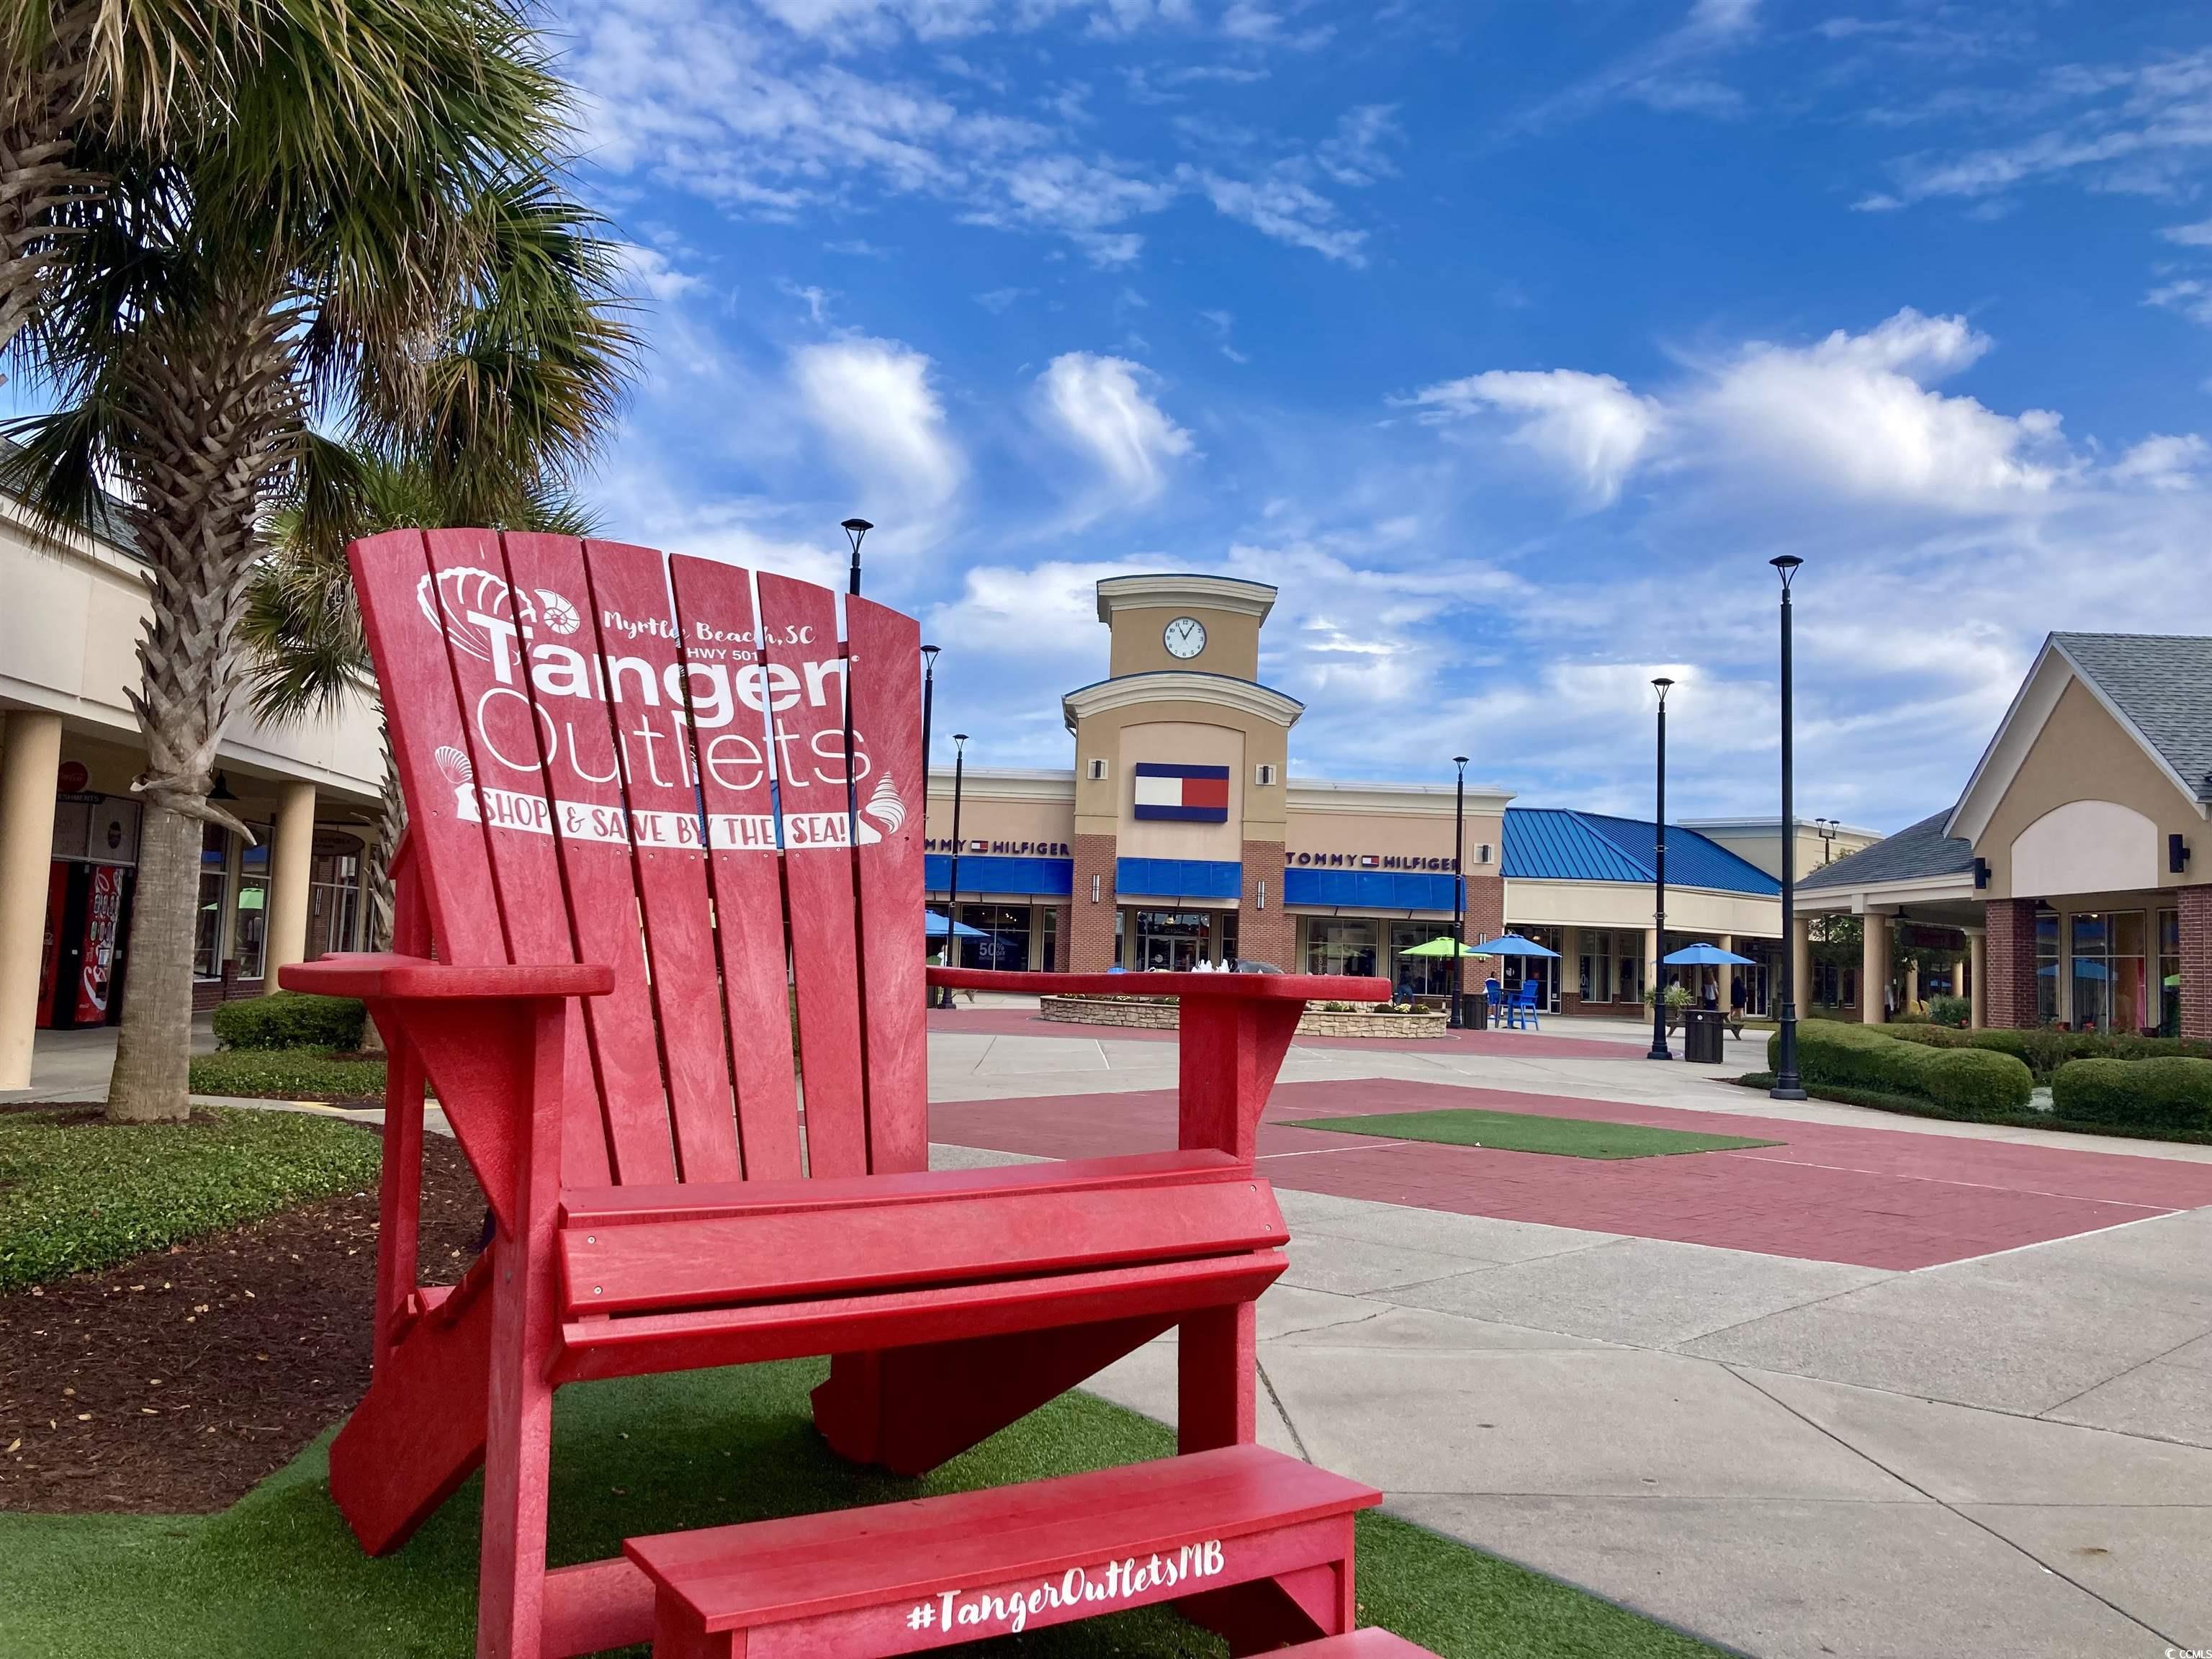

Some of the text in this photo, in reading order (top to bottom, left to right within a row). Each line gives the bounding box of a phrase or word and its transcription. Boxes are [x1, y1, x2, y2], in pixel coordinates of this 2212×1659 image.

[603, 611, 816, 646] Myrtle Beach, SC
[466, 609, 851, 729] Tanger
[686, 647, 758, 661] HWY 501
[477, 687, 871, 791] Outlets
[471, 788, 846, 845] SHOP & SAVE BY THE SEA!
[925, 838, 1069, 855] MMY HILFIGER
[1285, 852, 1358, 866] TOMMY
[906, 1539, 1225, 1633] #TangerOutletsMB
